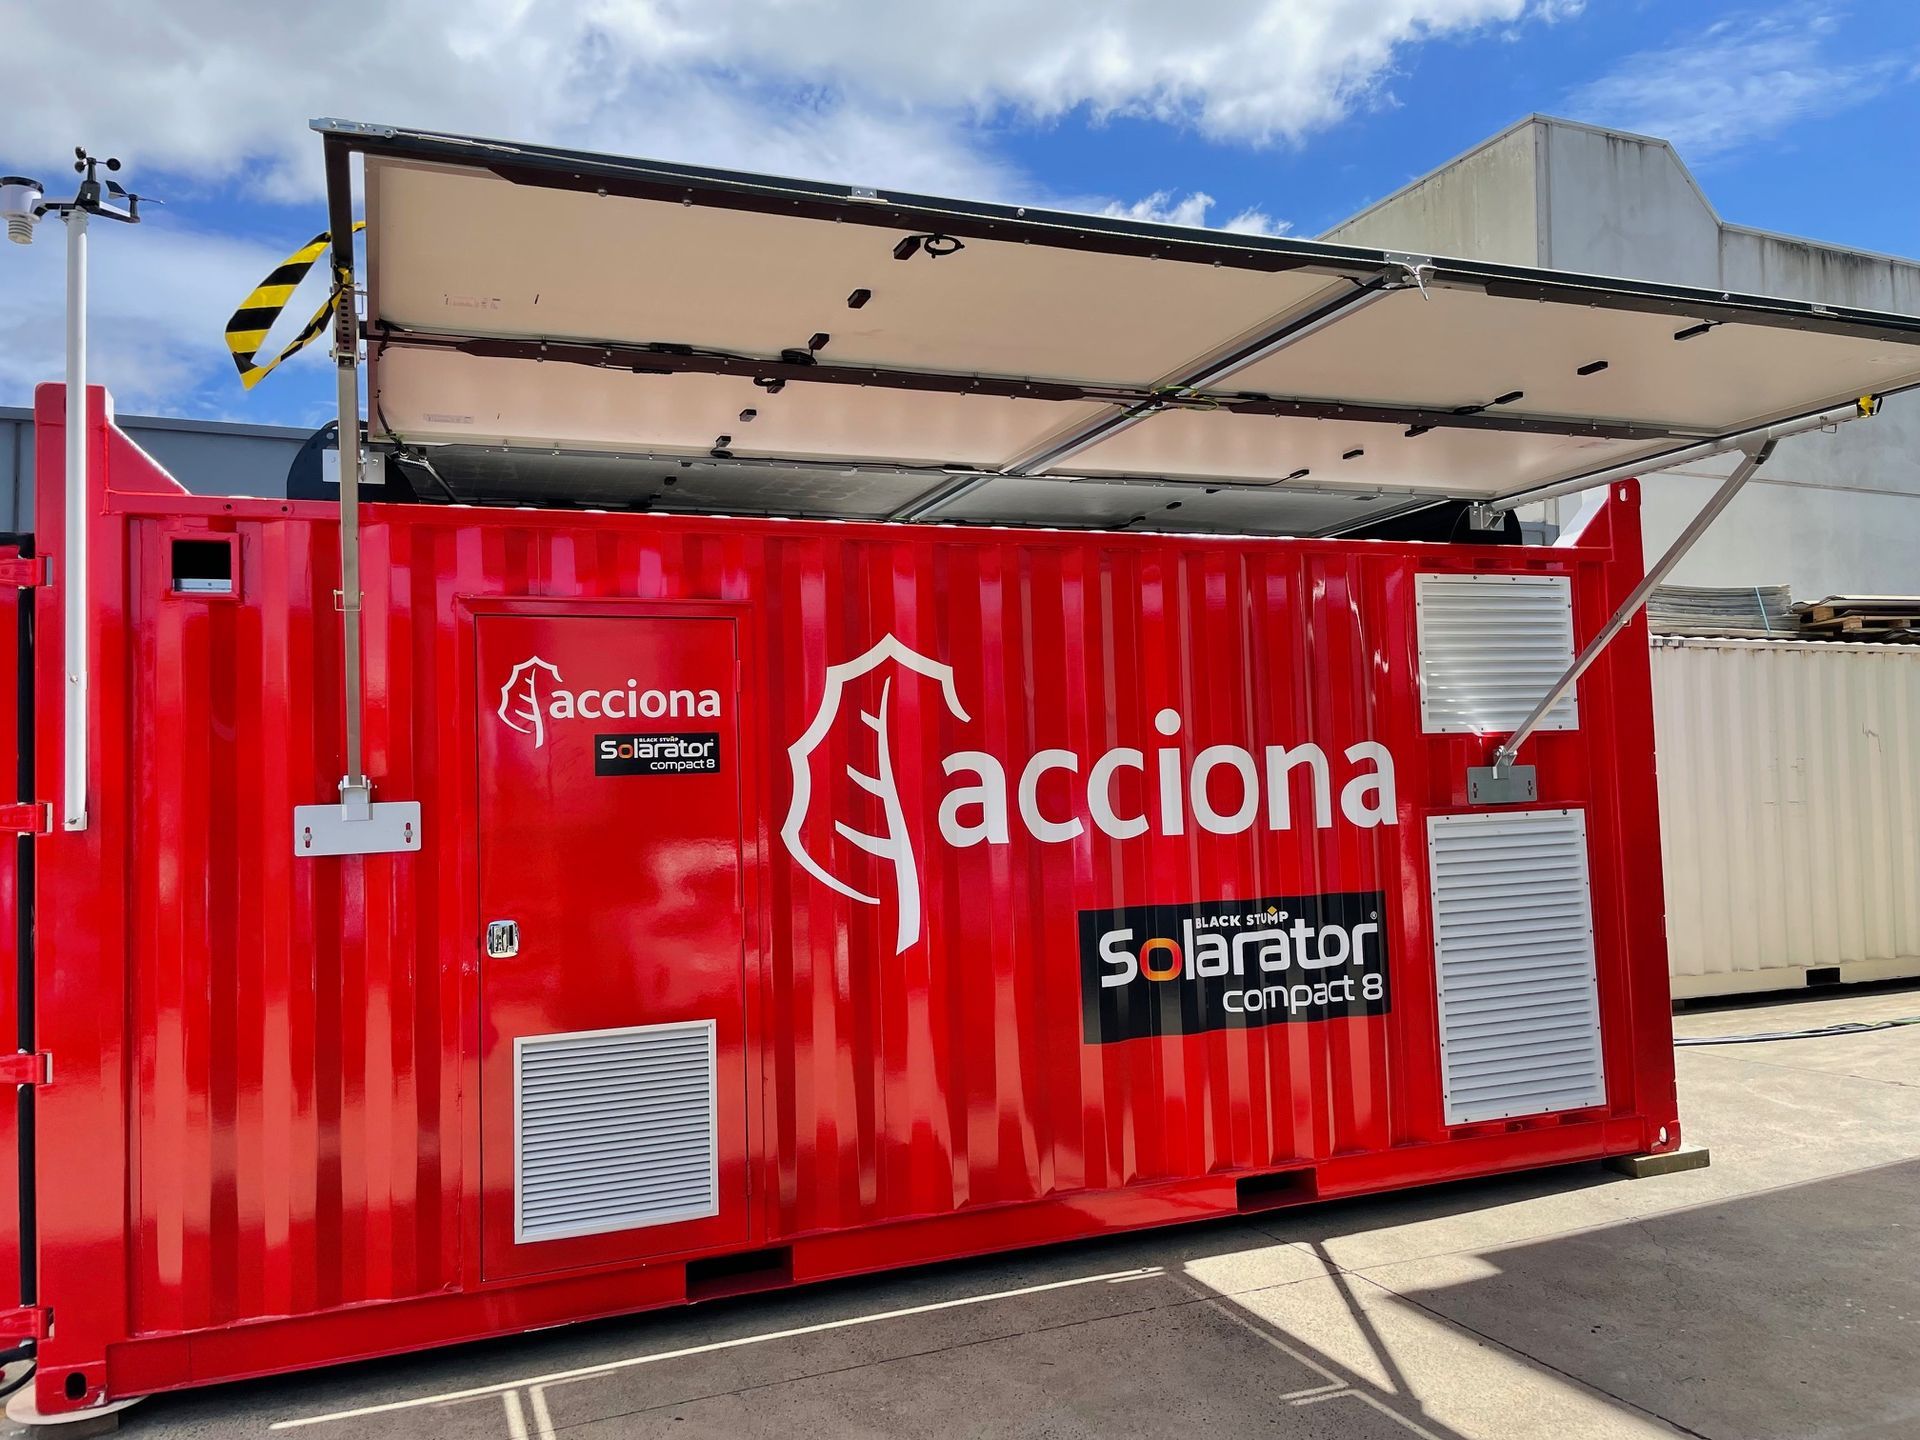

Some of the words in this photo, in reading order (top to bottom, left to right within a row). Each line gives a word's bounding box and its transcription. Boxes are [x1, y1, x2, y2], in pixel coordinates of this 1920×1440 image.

[549, 678, 721, 719] acciona
[600, 738, 714, 759] Solarator
[650, 759, 705, 772] compact
[706, 758, 716, 769] 8
[937, 708, 1399, 848] acciona
[1195, 914, 1241, 929] BLACK
[1246, 909, 1289, 927] STUMP
[1099, 918, 1378, 988] Solarator
[1222, 974, 1356, 1015] compact
[1362, 972, 1384, 1001] 8
